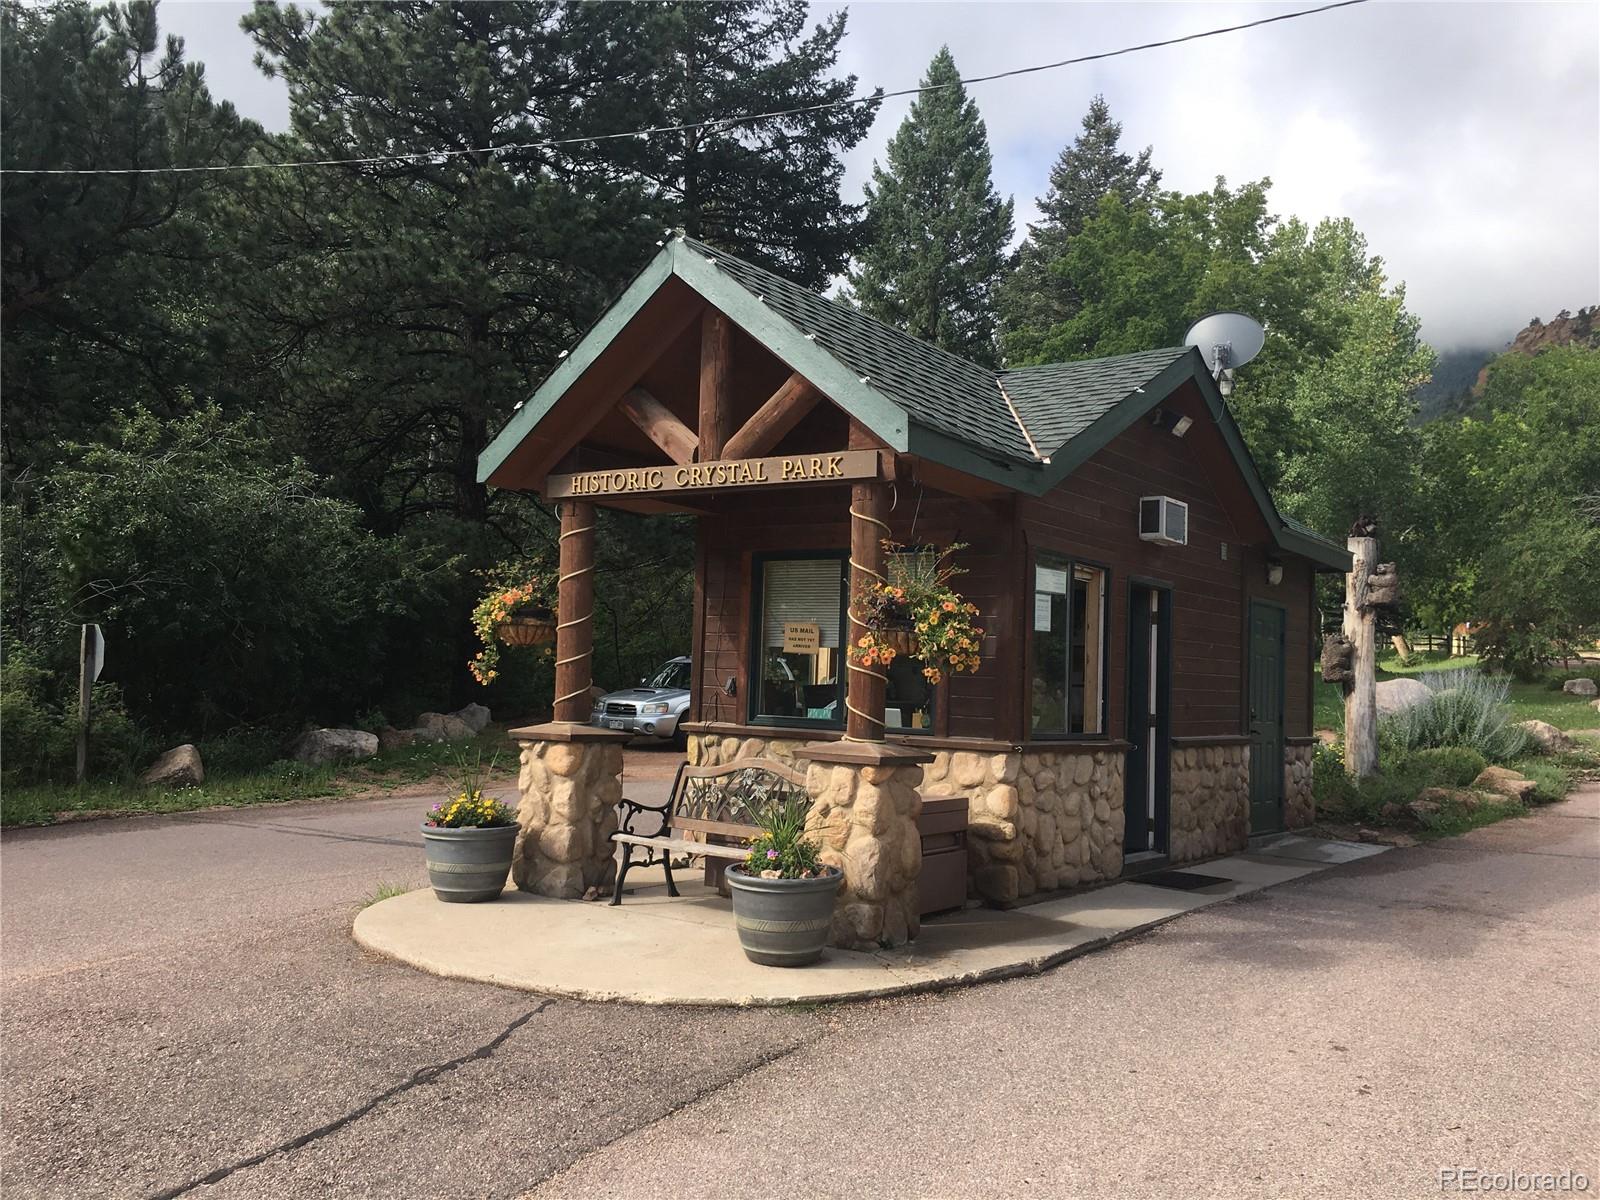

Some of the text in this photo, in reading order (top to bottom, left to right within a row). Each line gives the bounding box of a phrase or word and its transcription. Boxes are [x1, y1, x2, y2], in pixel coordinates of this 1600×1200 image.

[571, 456, 844, 494] HISTORIC CRYSTAL PARK
